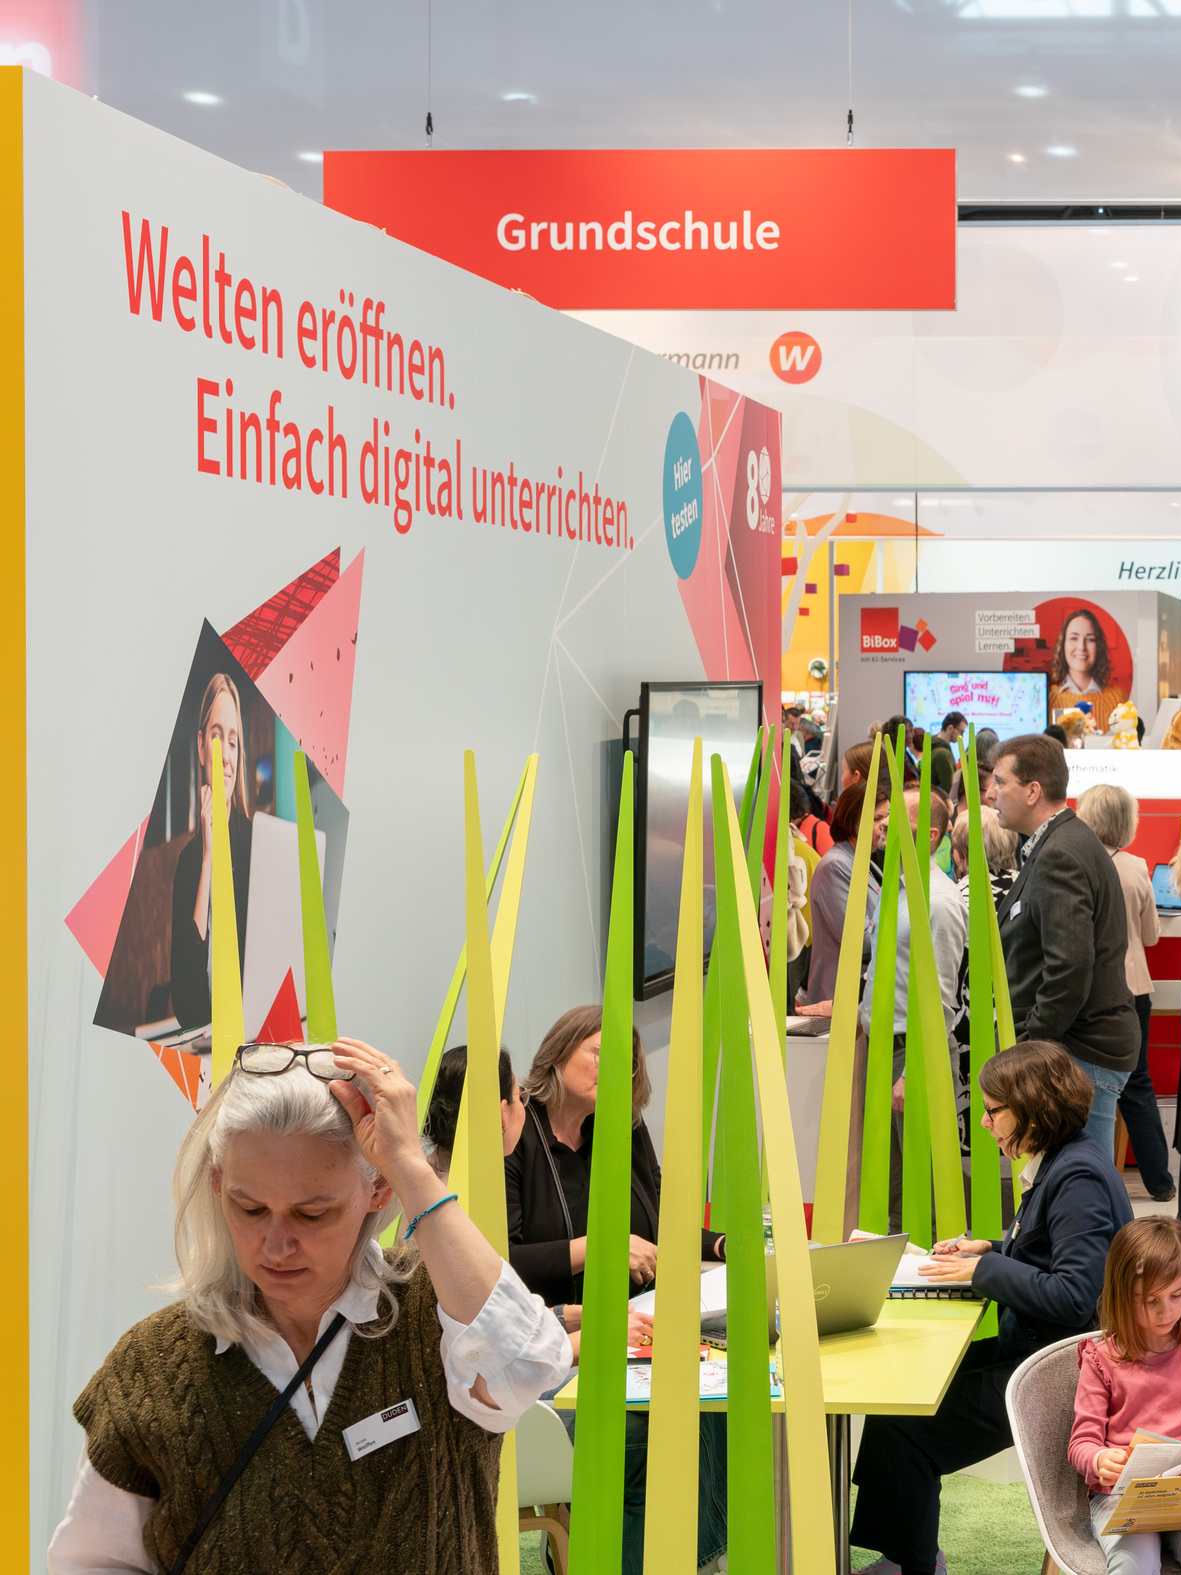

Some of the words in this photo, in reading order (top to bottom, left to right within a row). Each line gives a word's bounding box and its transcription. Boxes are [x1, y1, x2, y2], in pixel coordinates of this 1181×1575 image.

[497, 210, 781, 253] Grundschule
[121, 210, 283, 359] Welten
[297, 288, 455, 411] eröffnen.
[197, 377, 348, 499] Einfach
[359, 417, 463, 535] digital
[472, 461, 634, 551] unterrichten.
[673, 456, 692, 492] Hier
[670, 498, 698, 539] testen
[758, 509, 775, 535] Jahre
[978, 612, 1033, 623] Vorbereiten.
[862, 635, 897, 648] BiBox
[978, 626, 1038, 637] Unterrichten.
[978, 641, 1012, 651] Lernen.
[382, 1404, 408, 1420] DUDEN
